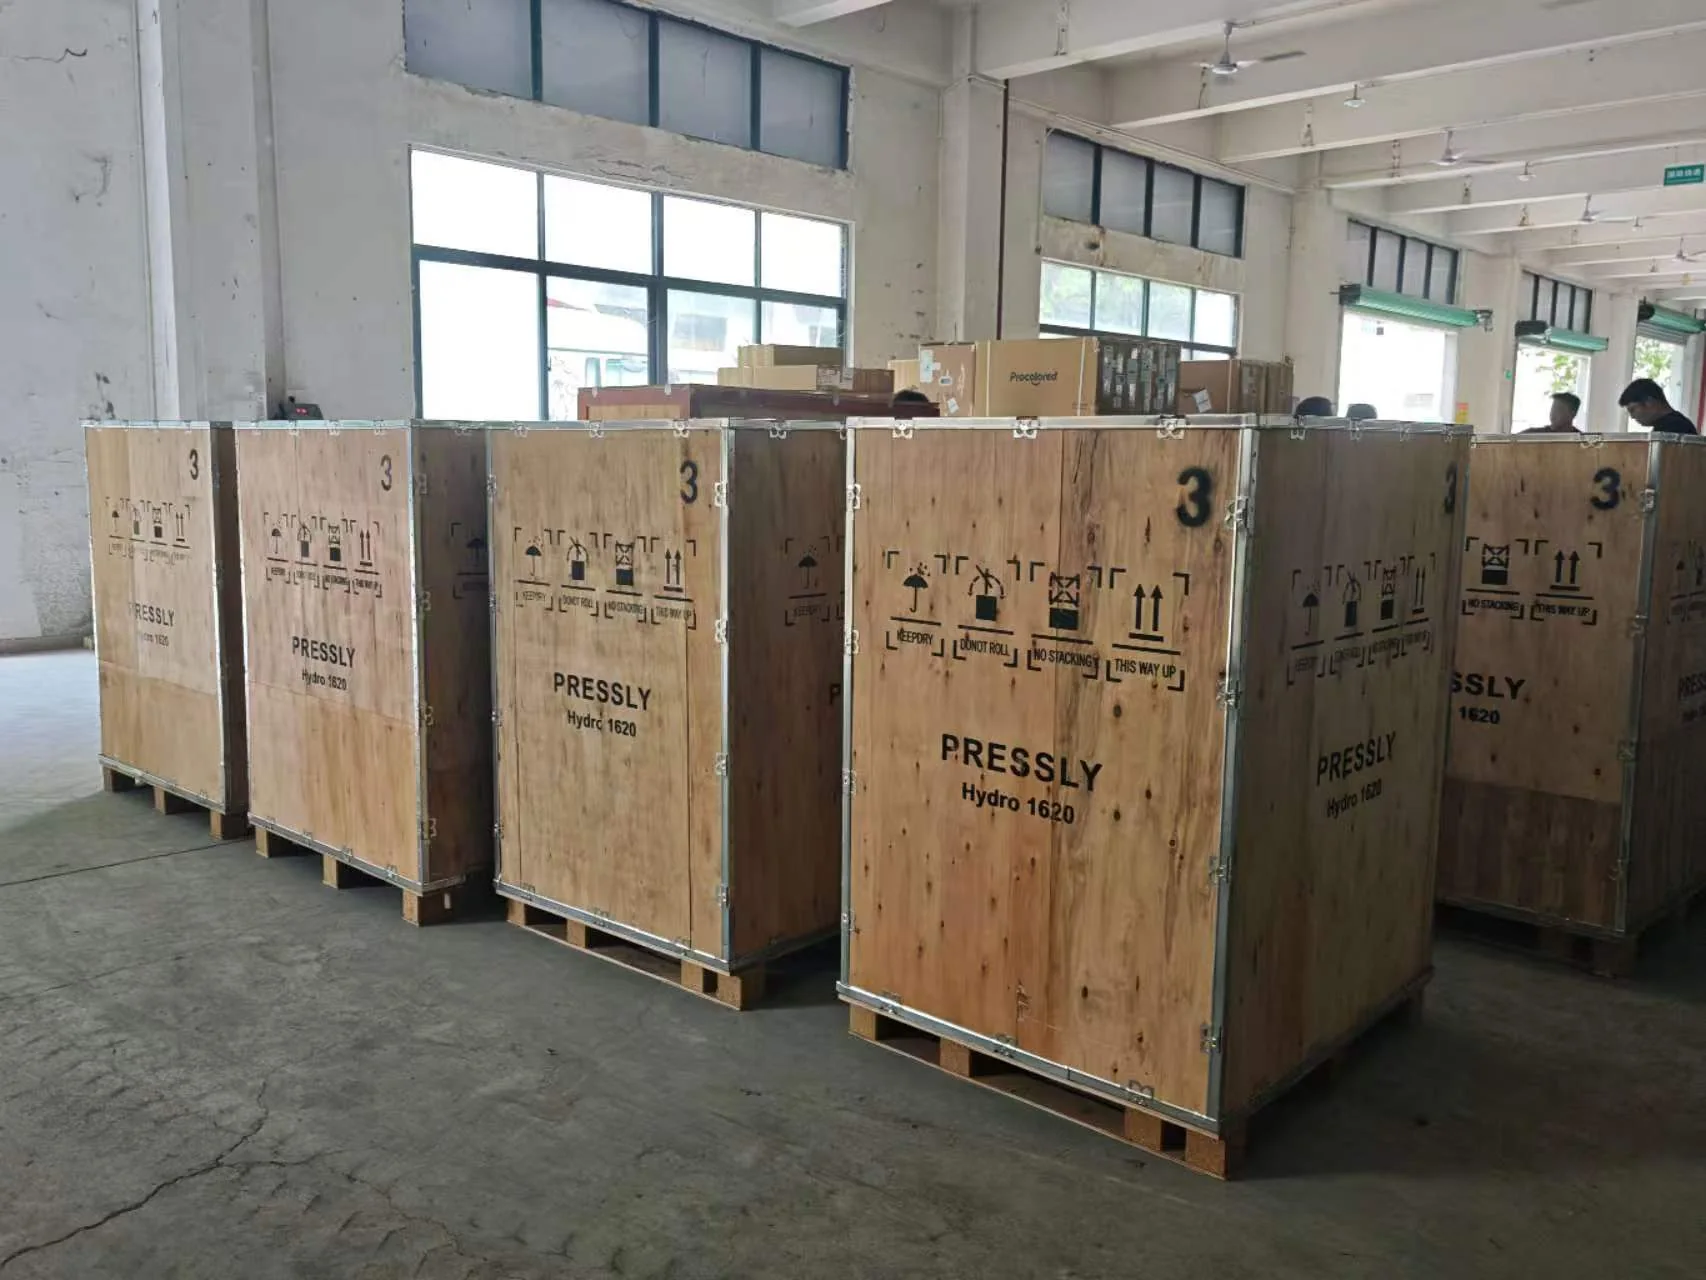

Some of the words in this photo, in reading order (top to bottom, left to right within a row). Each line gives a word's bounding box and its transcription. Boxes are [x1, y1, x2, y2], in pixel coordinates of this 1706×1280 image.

[189, 448, 200, 481] 3
[380, 454, 393, 491] 3
[679, 460, 698, 504] 3
[1174, 466, 1213, 528] 3
[1590, 466, 1622, 511] 3
[292, 636, 355, 668] PRESSLY
[897, 629, 934, 646] KEEPDRY
[960, 638, 988, 653] DONOT
[989, 641, 1010, 656] ROLL
[1033, 648, 1047, 662] NO
[1049, 650, 1093, 668] STACKING
[1115, 658, 1136, 674] THIS
[1139, 661, 1160, 677] WAY
[1162, 664, 1177, 679] UP
[302, 668, 326, 686] Hydro
[327, 675, 348, 691] 1620
[554, 672, 652, 711] PRESSLY
[608, 718, 637, 737] 1620
[1459, 706, 1500, 725] 1620
[942, 733, 1103, 792] PRESSLY
[1316, 730, 1396, 787] PRESSLY
[962, 782, 1020, 812] Hydro
[1027, 797, 1075, 824] 1620
[1326, 793, 1358, 819] Hydro
